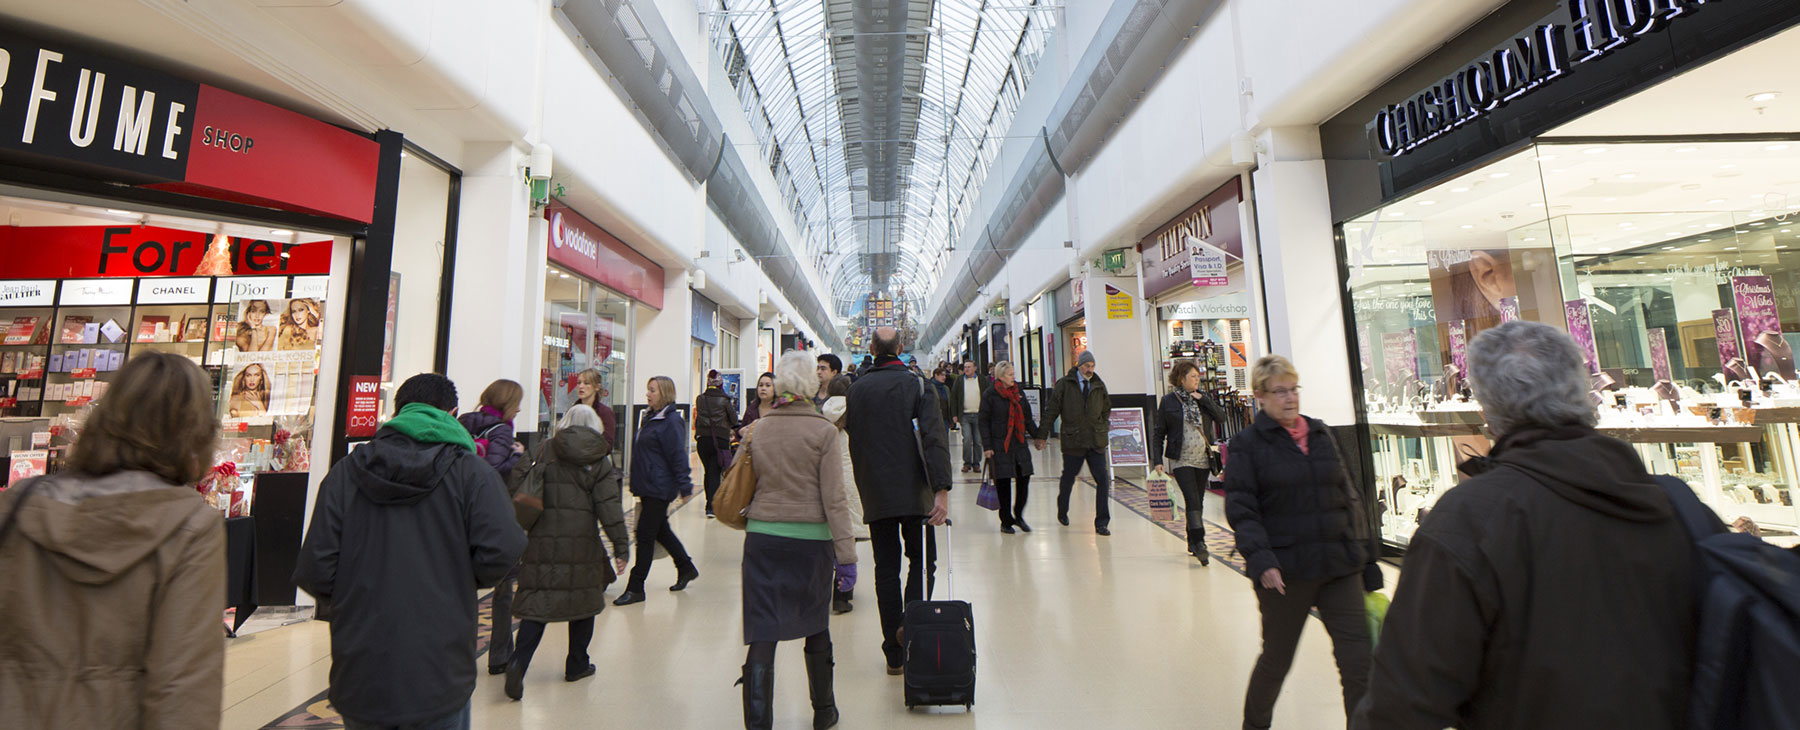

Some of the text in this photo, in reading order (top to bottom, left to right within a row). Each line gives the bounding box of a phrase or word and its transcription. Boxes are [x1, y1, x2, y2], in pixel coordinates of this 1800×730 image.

[1375, 24, 1570, 158] CHISHOLM
[202, 126, 254, 154] SHOP
[1157, 205, 1213, 262] TIMPSON
[564, 227, 596, 260] vodafone
[98, 227, 192, 274] For
[2, 284, 38, 293] Jean Paul
[152, 286, 196, 295] CHANEL
[235, 283, 269, 296] Dior
[1735, 283, 1771, 298] Christmas
[1372, 297, 1384, 309] the
[1385, 301, 1399, 309] one
[1400, 300, 1413, 313] you
[1415, 296, 1432, 309] love
[1744, 295, 1774, 308] Wishes
[1166, 303, 1248, 315] Watch Workshop
[1413, 309, 1427, 320] this
[237, 351, 313, 362] MICHAEL KORS
[355, 382, 378, 392] NEW
